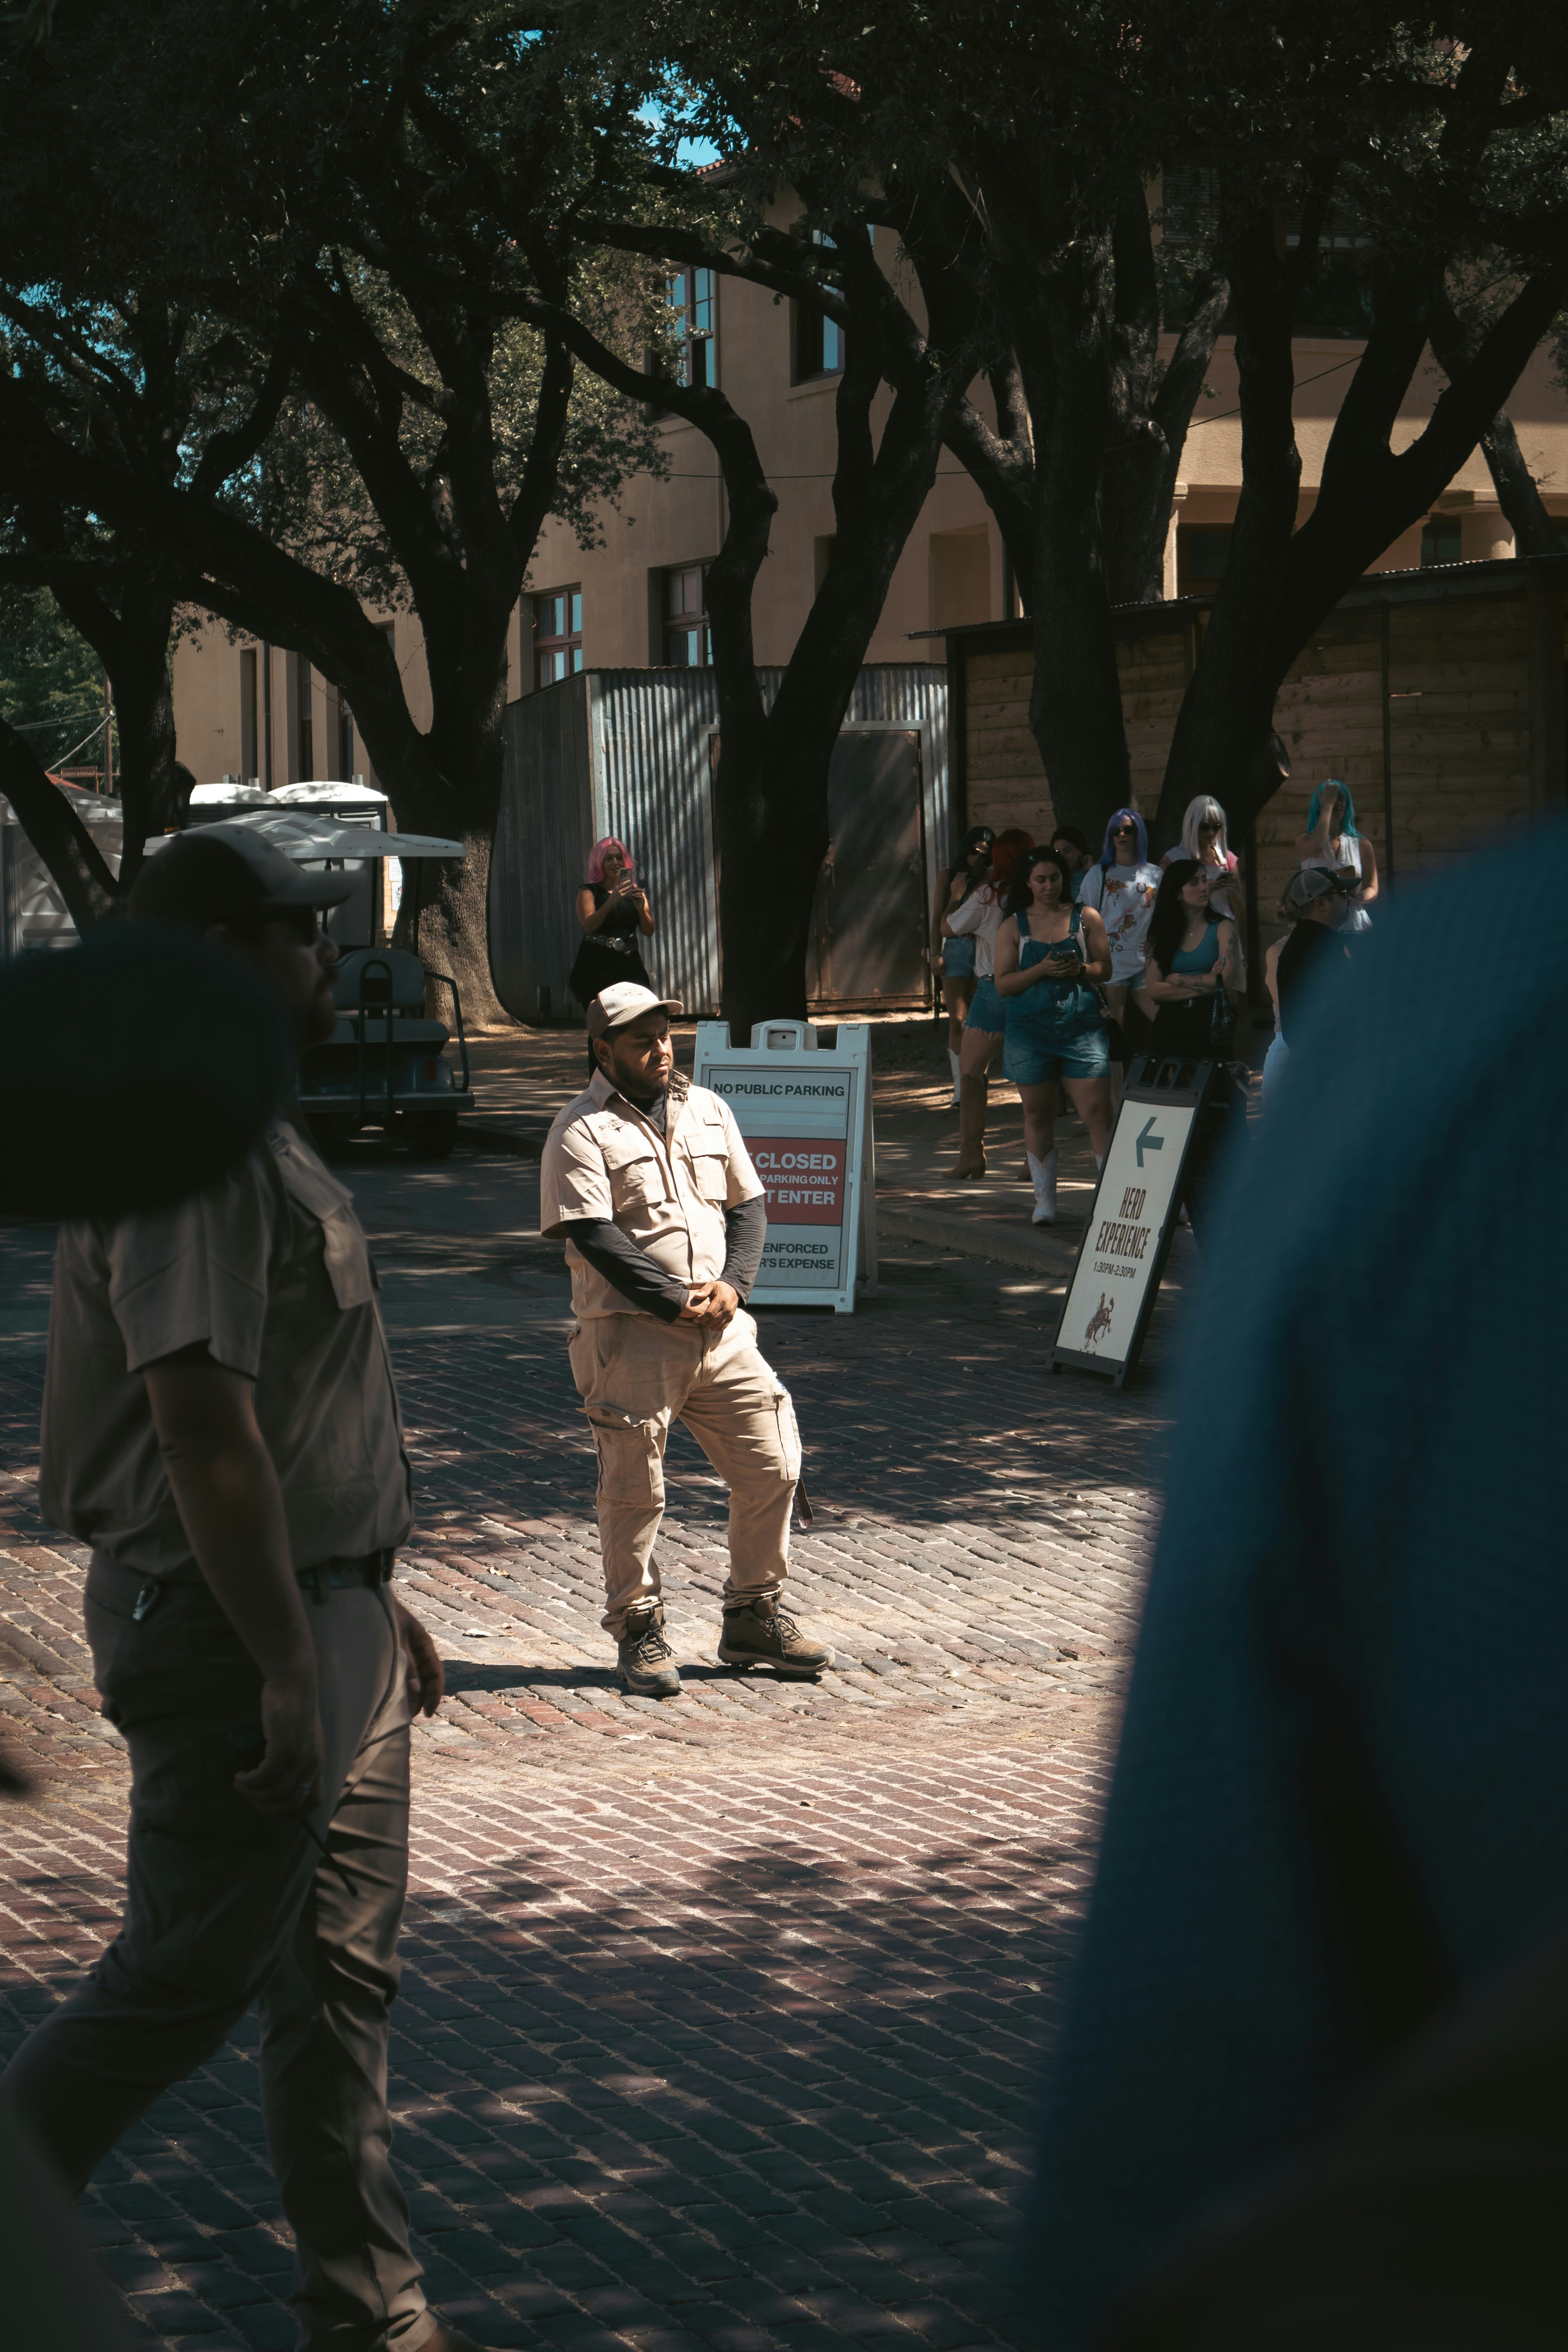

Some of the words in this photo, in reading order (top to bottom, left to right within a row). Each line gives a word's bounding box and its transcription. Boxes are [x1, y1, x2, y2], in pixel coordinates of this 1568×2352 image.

[714, 1083, 733, 1094] NO
[735, 1084, 782, 1095] PUBLIC
[785, 1085, 844, 1097] PARKING
[599, 1121, 629, 1131] STOCKYAS
[755, 1152, 836, 1169] CLOSED
[759, 1174, 808, 1184] PARKING
[809, 1176, 839, 1185] ONLY
[777, 1190, 835, 1205] ENTER
[1118, 1187, 1147, 1220] HERD
[1095, 1221, 1151, 1259] EXPERIENCE
[763, 1243, 828, 1254] ENFORCED
[778, 1258, 835, 1269] EXPENSE
[1093, 1261, 1137, 1279] 1:30PM-2:30PM
